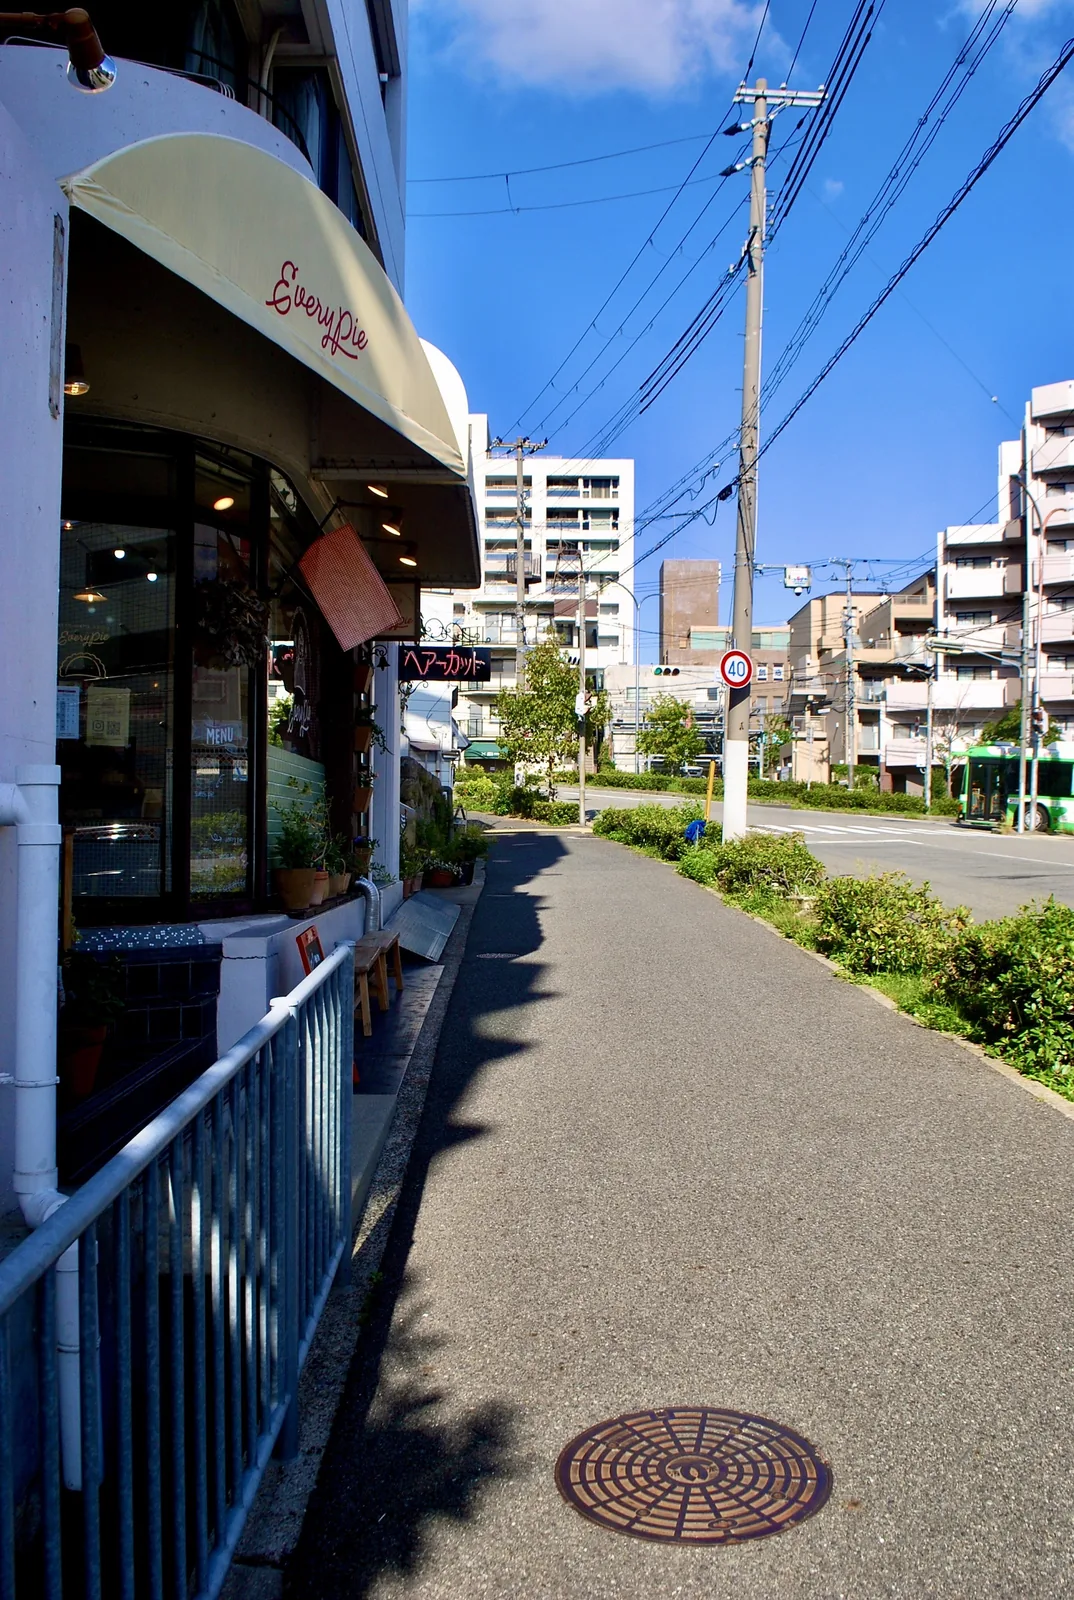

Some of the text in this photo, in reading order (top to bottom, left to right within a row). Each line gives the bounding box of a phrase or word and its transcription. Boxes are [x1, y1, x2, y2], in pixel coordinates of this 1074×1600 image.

[404, 649, 486, 676] ヘアーカット
[728, 661, 746, 677] 40
[205, 727, 235, 745] MENU
